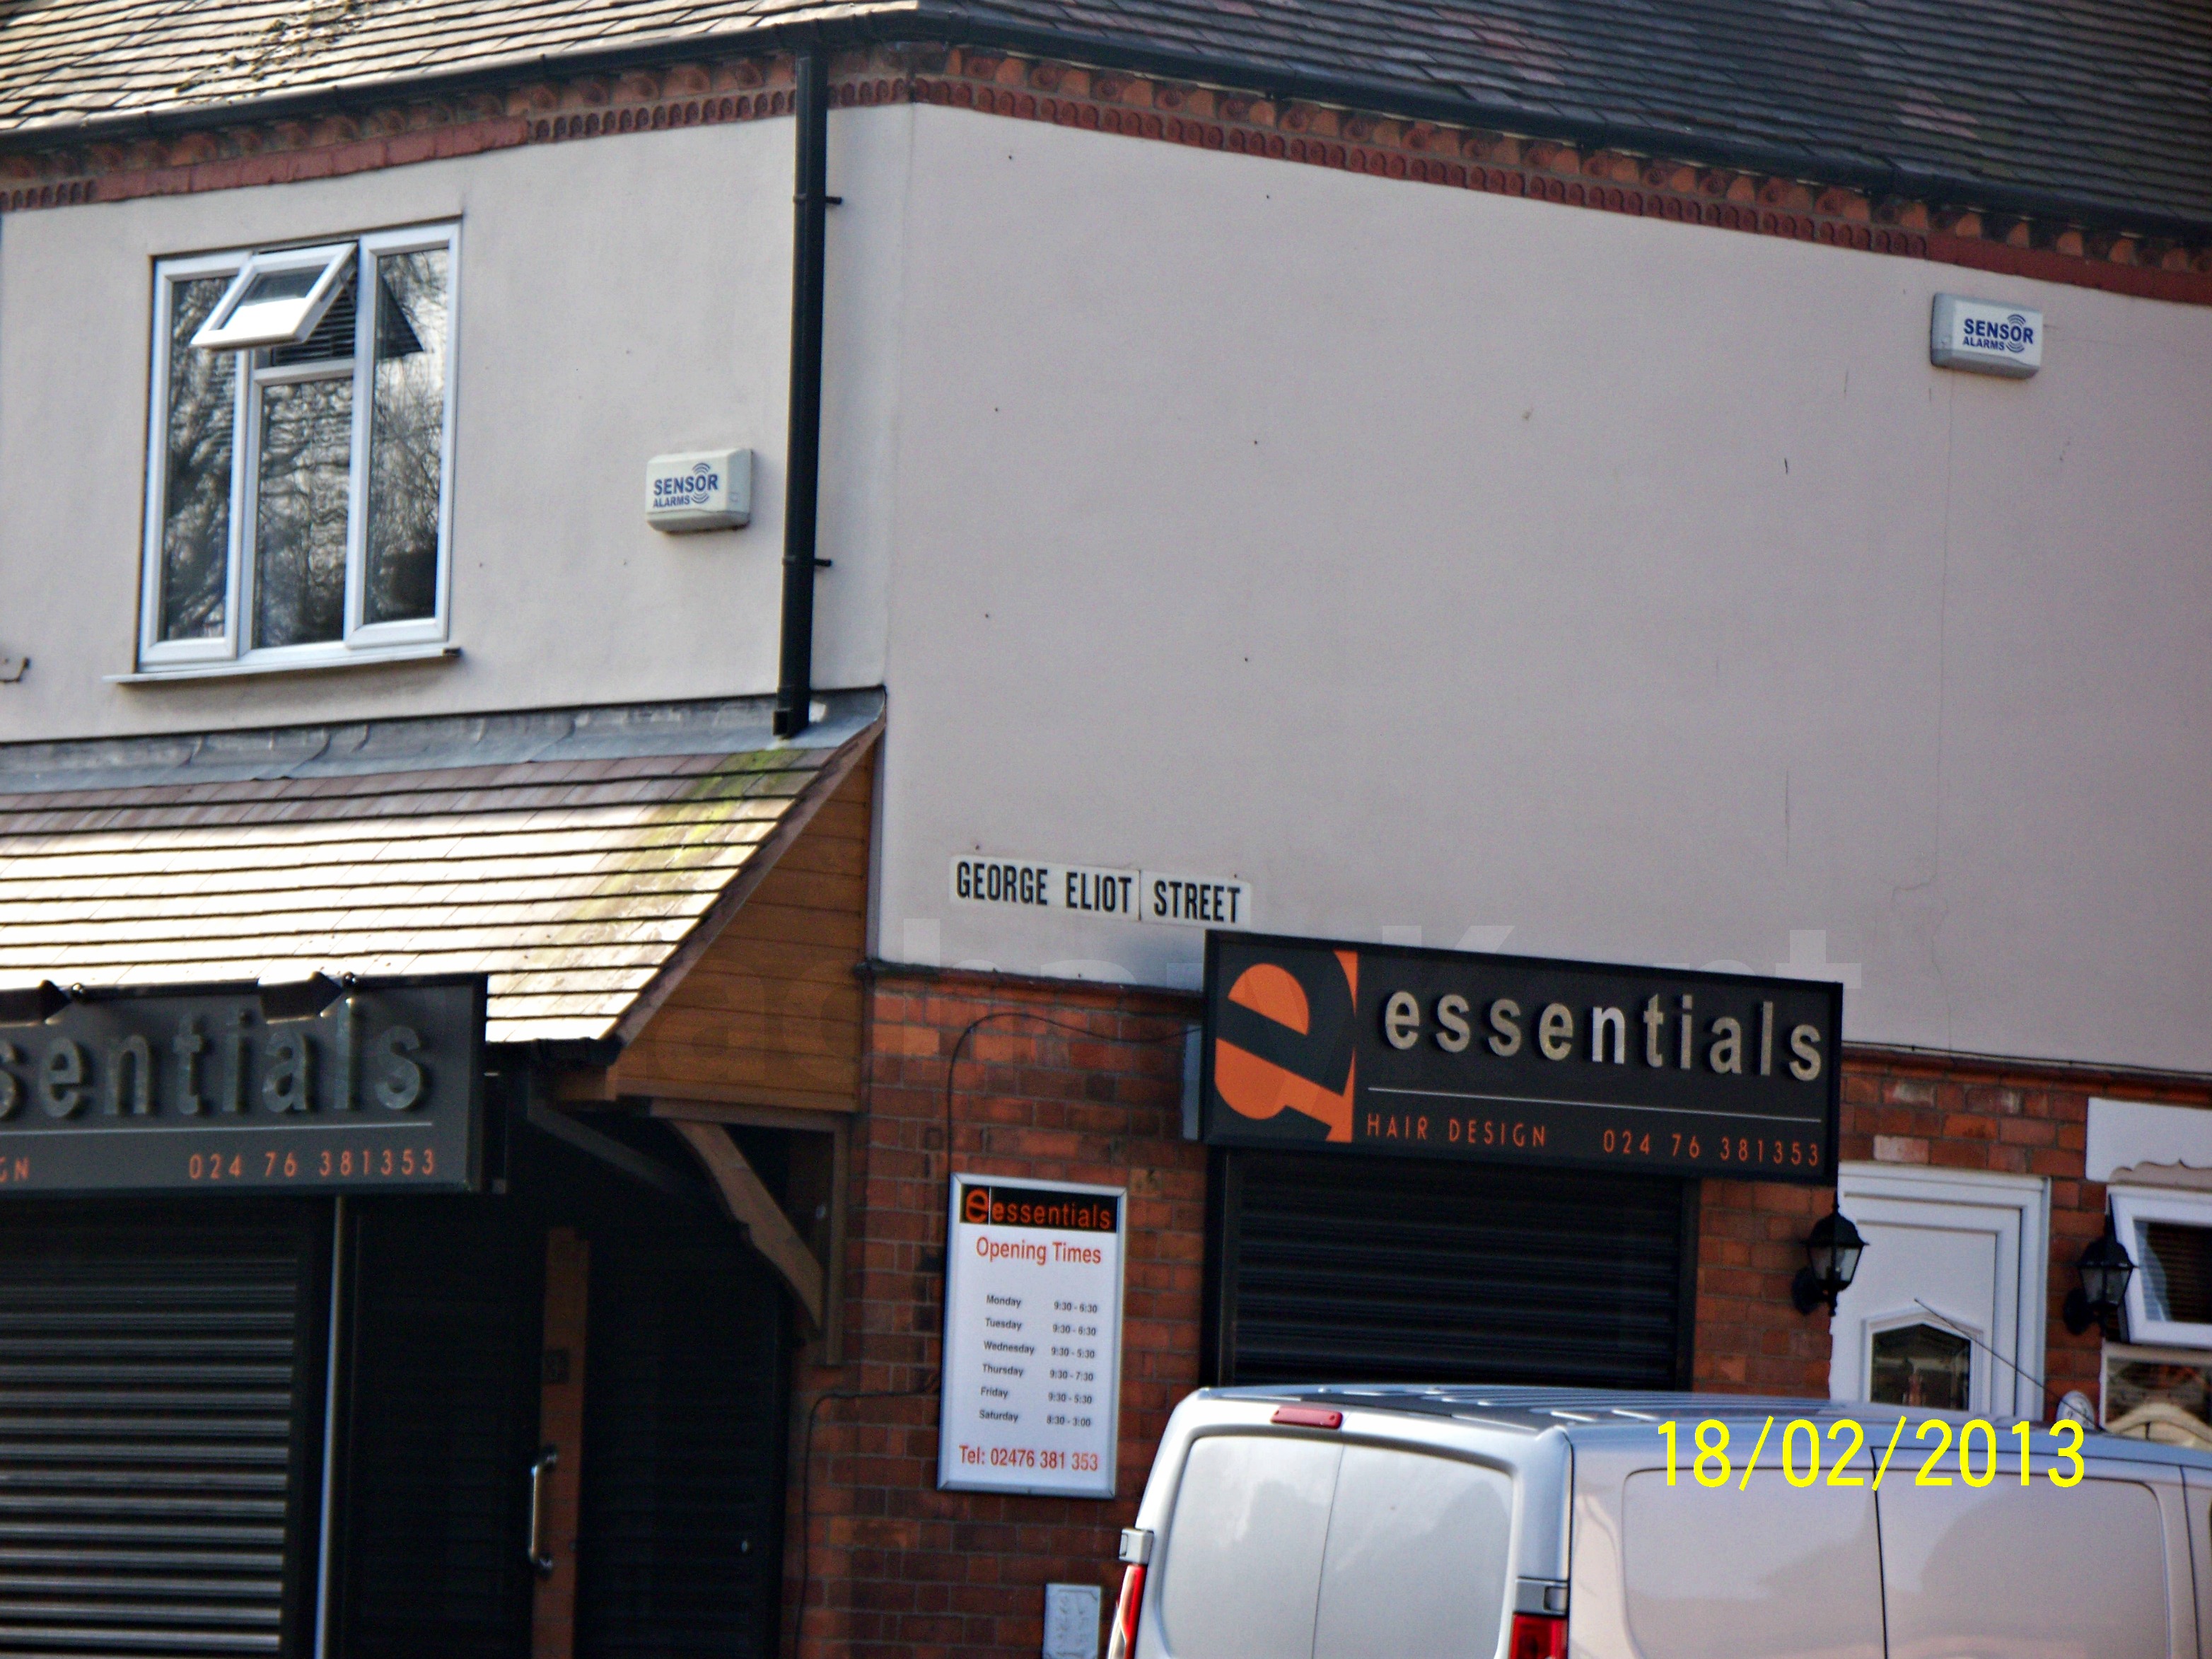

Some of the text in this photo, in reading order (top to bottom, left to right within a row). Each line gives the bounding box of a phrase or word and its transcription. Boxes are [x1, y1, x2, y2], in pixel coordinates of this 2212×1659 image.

[1964, 318, 2034, 344] SENSOR
[1963, 337, 2006, 351] ALARMS
[653, 474, 718, 496] SENSOR
[653, 495, 690, 508] ALARMS
[956, 861, 1241, 923] GEORGE ELIOT STREET
[1384, 990, 1822, 1082] essentials
[1367, 1113, 1819, 1168] HAIR DESIGN 024 76 381353
[189, 1154, 242, 1180] 024
[264, 1151, 298, 1176] 76
[320, 1148, 433, 1175] 381353
[991, 1201, 1112, 1230] essentials
[976, 1236, 1102, 1265] Opening Times
[986, 1295, 1021, 1308] Monday
[1054, 1301, 1072, 1311] 9:30
[1079, 1304, 1098, 1313] 6:30
[985, 1317, 1022, 1332] Tuesday
[1052, 1325, 1071, 1334] 9:30
[1078, 1327, 1096, 1336] 6:30
[984, 1341, 1035, 1356] Wednesday
[1051, 1346, 1069, 1357] 9:30
[1077, 1349, 1095, 1358] 5:30
[982, 1363, 1024, 1378] Thursday
[1049, 1370, 1068, 1379] 9:30
[1076, 1372, 1093, 1382] 7:30
[981, 1387, 1008, 1400] Friday
[1048, 1392, 1066, 1402] 9:30
[1073, 1395, 1093, 1404] 5:30
[979, 1410, 1018, 1424] Saturday
[1073, 1417, 1091, 1427] 3:00
[959, 1445, 1098, 1472] Tel: 02476 381 353
